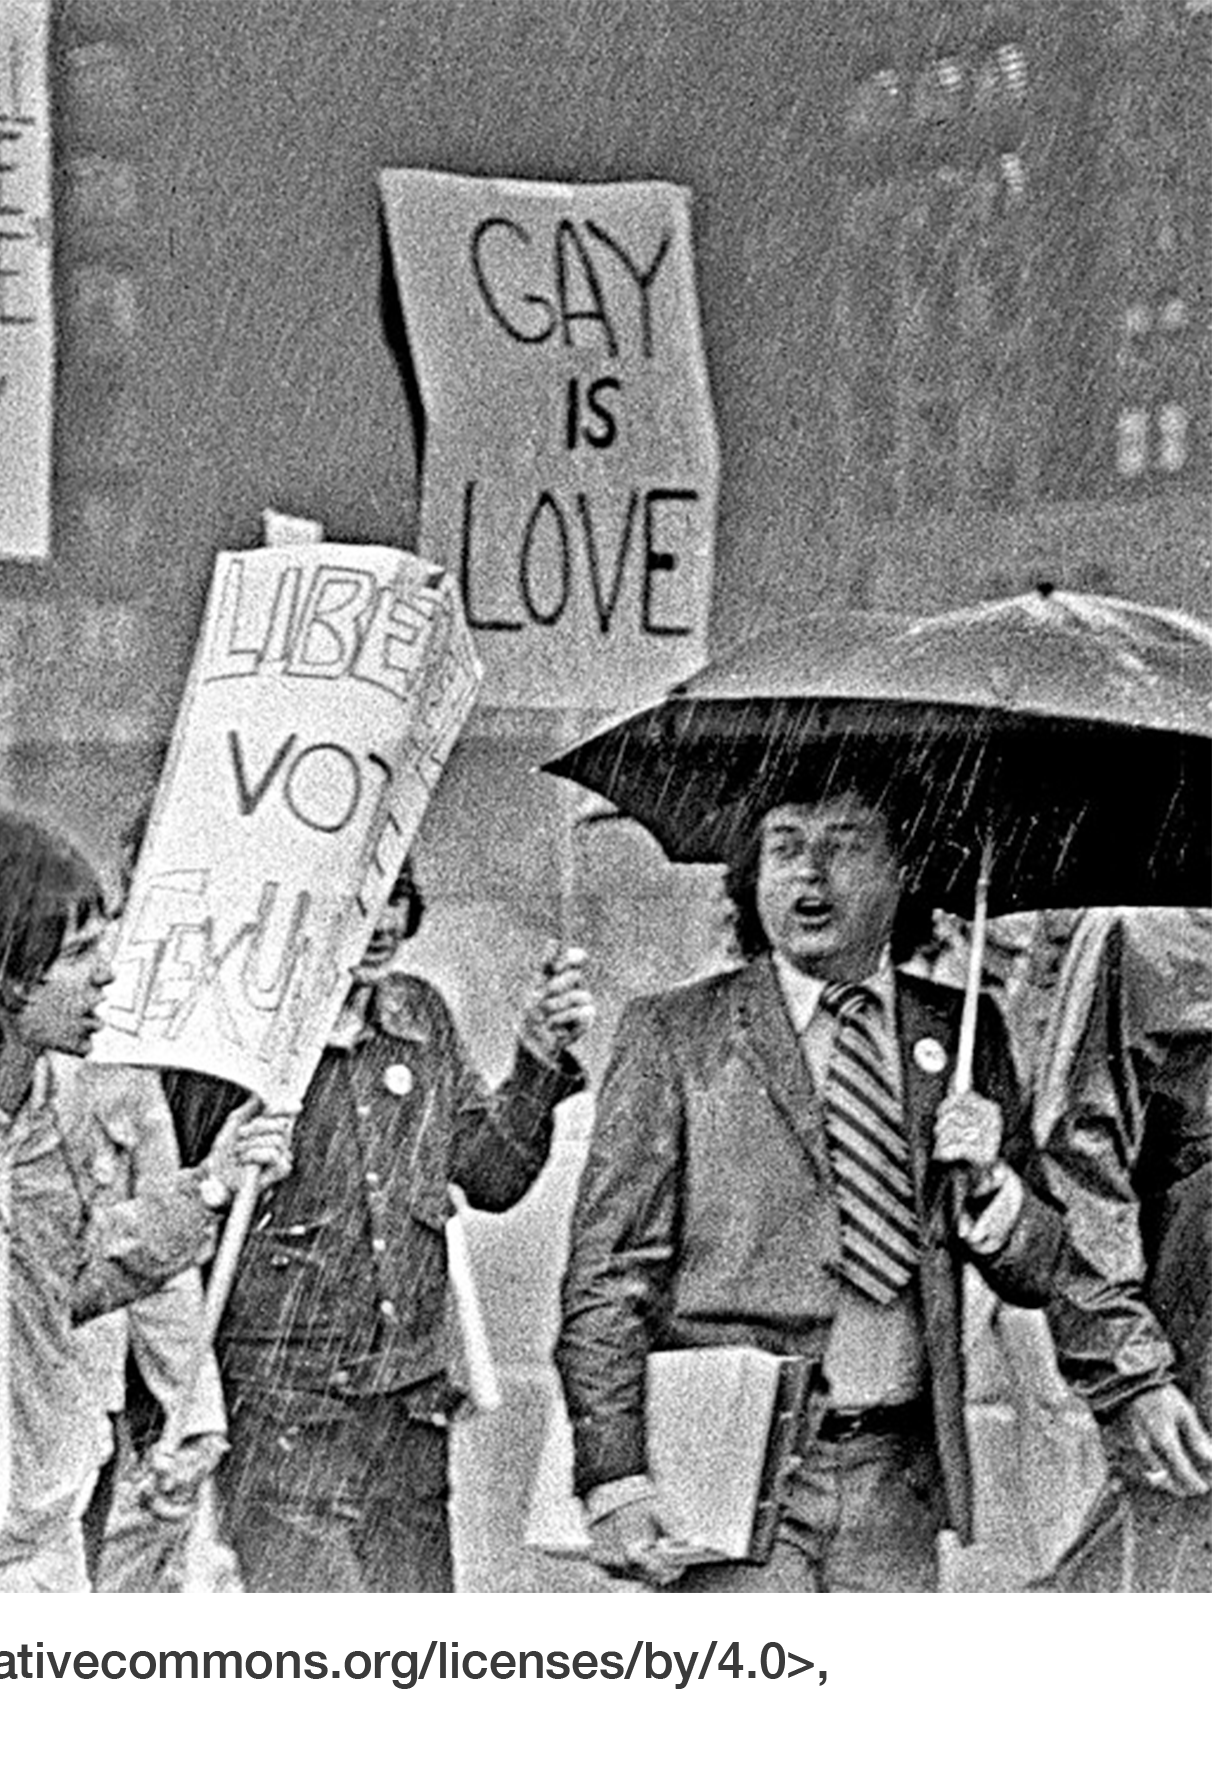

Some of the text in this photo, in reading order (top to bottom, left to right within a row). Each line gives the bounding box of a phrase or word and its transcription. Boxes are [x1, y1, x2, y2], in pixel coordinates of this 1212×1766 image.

[470, 215, 672, 357] GAY
[566, 376, 622, 450] IS
[460, 478, 699, 634] LOVE
[202, 557, 443, 703] LIBE
